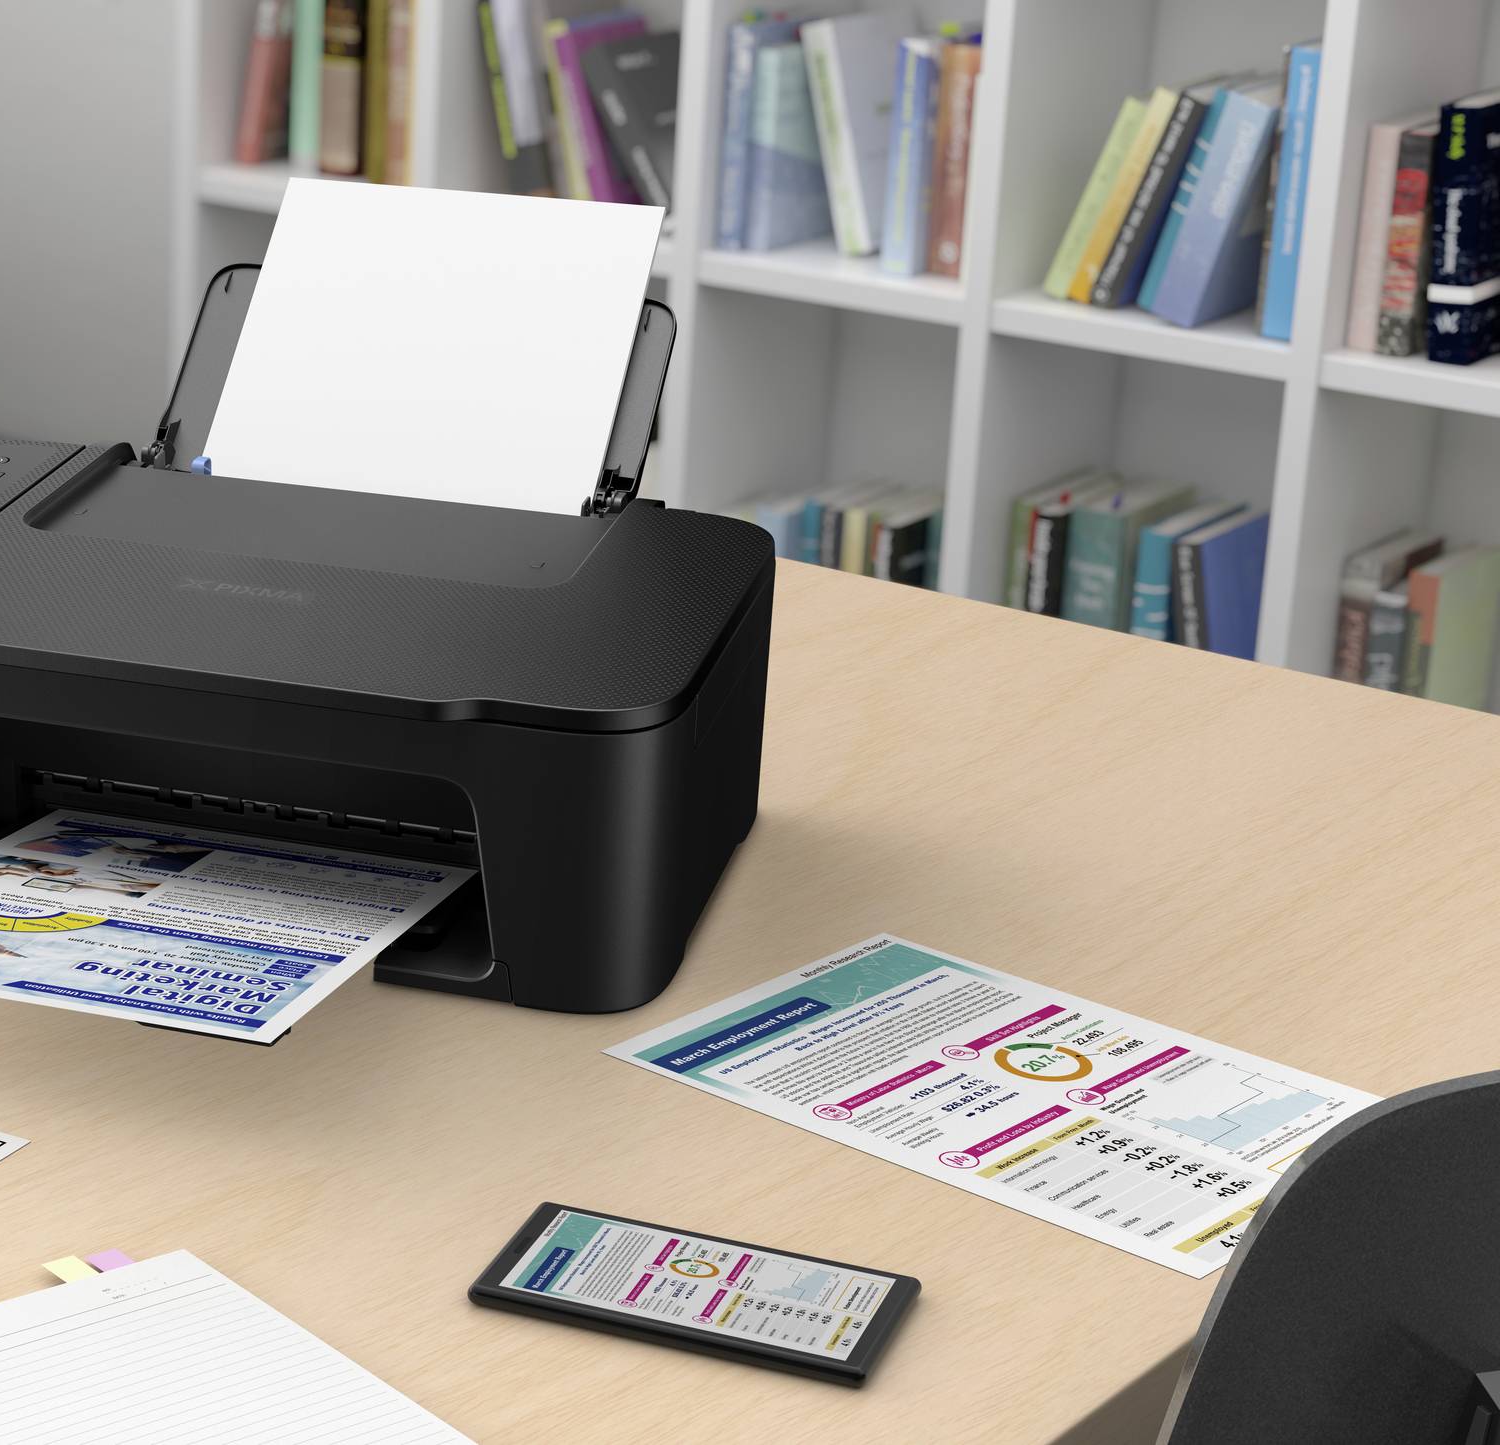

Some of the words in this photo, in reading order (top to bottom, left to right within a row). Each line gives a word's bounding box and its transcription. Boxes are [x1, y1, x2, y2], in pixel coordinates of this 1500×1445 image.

[213, 582, 303, 602] PIXMA
[147, 903, 211, 916] marketing
[117, 920, 153, 931] basics
[213, 914, 255, 923] digital
[275, 923, 327, 935] benefits
[201, 934, 258, 947] marketing
[259, 945, 295, 953] digital
[185, 945, 234, 955] registered
[297, 951, 329, 959] Learn
[800, 964, 834, 978] Monthly
[829, 950, 867, 966] Research
[863, 939, 892, 951] Report
[212, 955, 266, 966] Community
[75, 962, 277, 1003] Marketing
[129, 960, 291, 991] Seminar
[24, 983, 79, 996] Utilisation
[104, 997, 149, 1007] Analysis
[124, 985, 262, 1014] Digital
[150, 1004, 177, 1012] Data
[207, 1014, 246, 1024] Results
[1027, 1026, 1055, 1039] Project
[1050, 1012, 1082, 1027] Manager
[670, 1049, 711, 1066] March
[707, 1018, 780, 1050] Employment
[775, 1002, 817, 1020] Report
[1072, 1030, 1104, 1045] 22,493
[1108, 1039, 1144, 1057] 108,495
[1021, 1054, 1065, 1072] 20.7%
[910, 1088, 935, 1100] +103
[933, 1073, 968, 1089] thousand
[960, 1079, 984, 1090] 4.1%
[941, 1095, 977, 1112] $26.82
[973, 1084, 1000, 1097] 0.3%
[974, 1100, 999, 1113] 34.5
[996, 1092, 1019, 1103] hours
[976, 1141, 998, 1152] Profit
[995, 1135, 1010, 1143] and
[1006, 1128, 1025, 1137] Loss
[1030, 1111, 1059, 1125] Industry
[1075, 1129, 1110, 1146] +1.2%
[1098, 1138, 1134, 1154] +0.9%
[995, 1160, 1015, 1170] Work
[1011, 1148, 1039, 1162] Increase
[1145, 1154, 1180, 1171] +0.2%
[1192, 1171, 1228, 1188] +1.6%
[1216, 1180, 1252, 1197] +0.5%
[1195, 1221, 1234, 1242] Unemployed
[532, 1278, 545, 1288] March
[539, 1256, 563, 1279] Employment
[558, 1249, 568, 1258] Report
